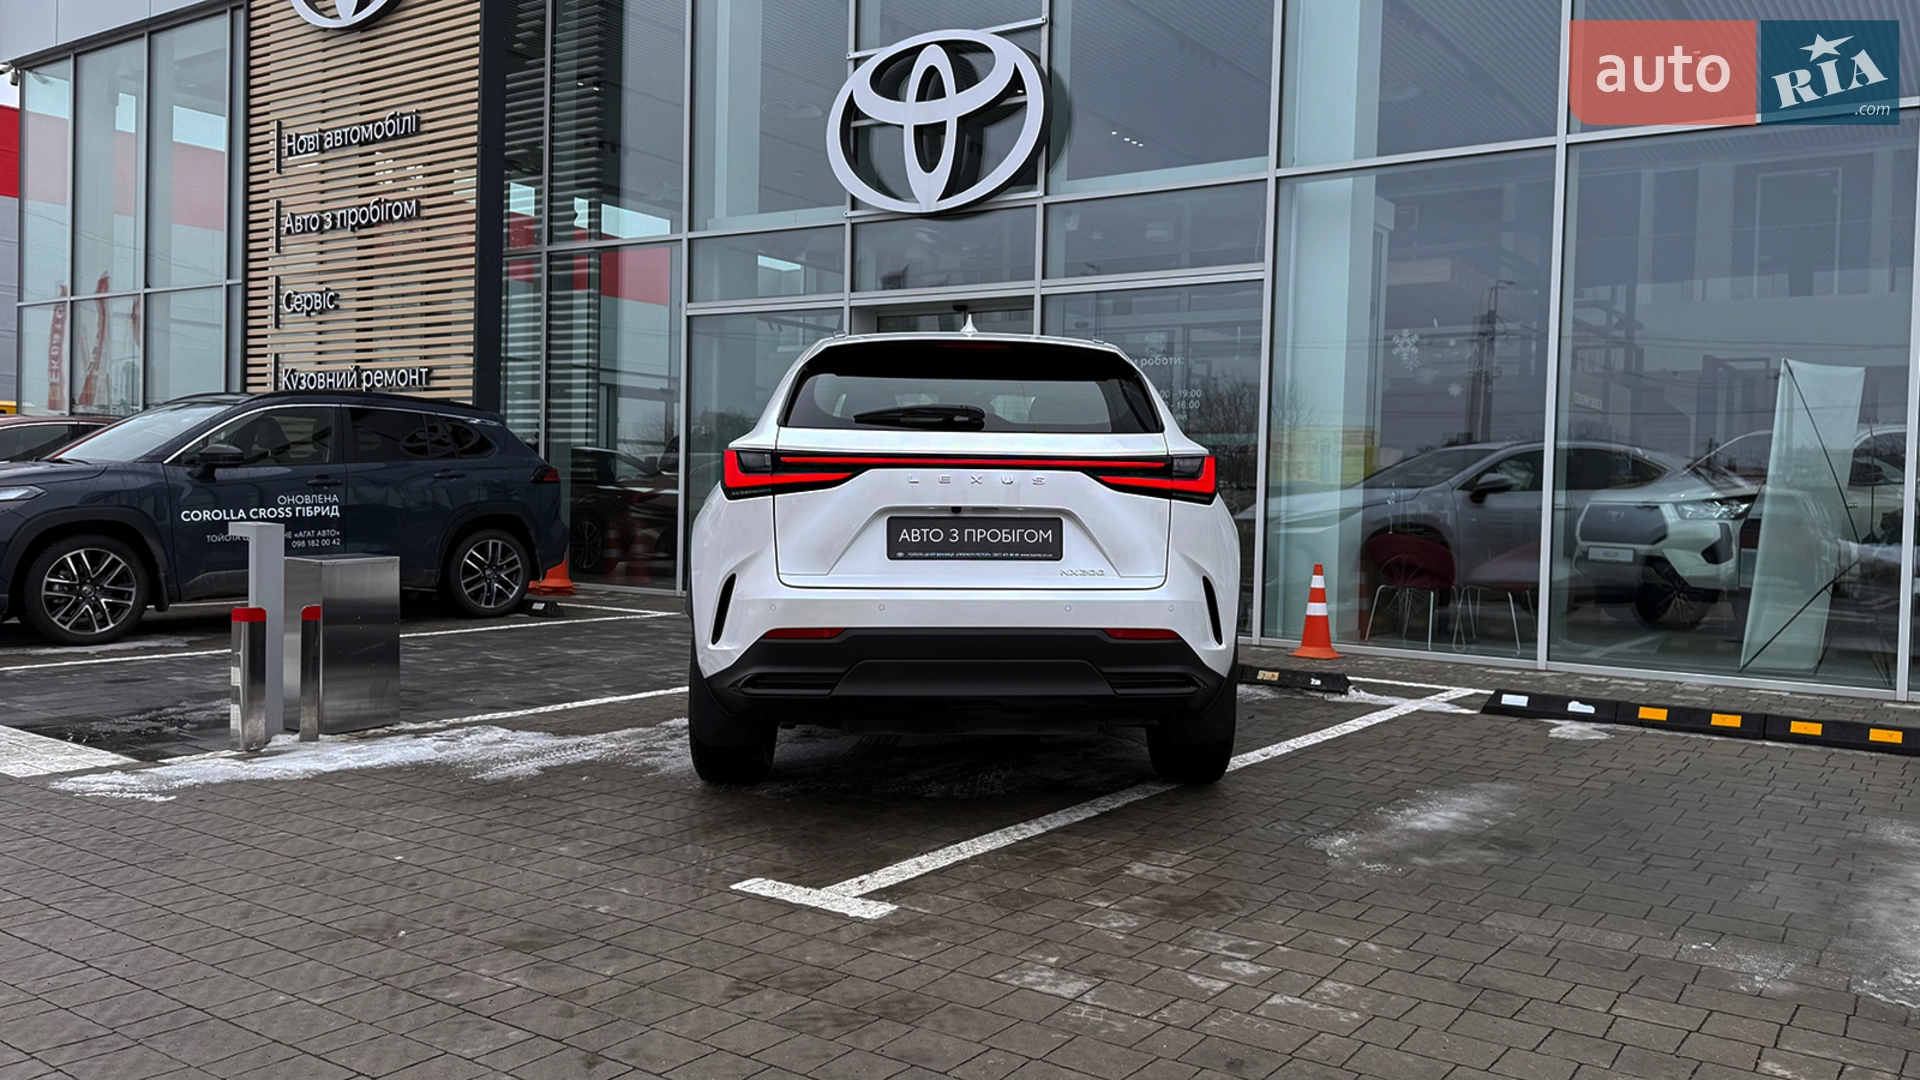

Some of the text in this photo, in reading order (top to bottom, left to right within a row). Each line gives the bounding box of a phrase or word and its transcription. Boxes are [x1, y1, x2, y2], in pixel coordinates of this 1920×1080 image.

[285, 108, 417, 156] Нові автомобілі
[284, 197, 417, 234] Авто з пробігом
[282, 287, 336, 316] Сервіс
[1141, 354, 1184, 368] роботи:
[282, 365, 429, 392] Кузовний ремонт
[907, 474, 1046, 486] LEXUS
[277, 494, 340, 505] ОНОВЛЕНА
[180, 504, 341, 522] COROLLA CROSS ГІБРИД
[291, 540, 307, 548] 098
[307, 539, 320, 547] 182
[332, 538, 341, 546] 42
[899, 528, 1053, 544] АВТО З ПРОБІГОМ
